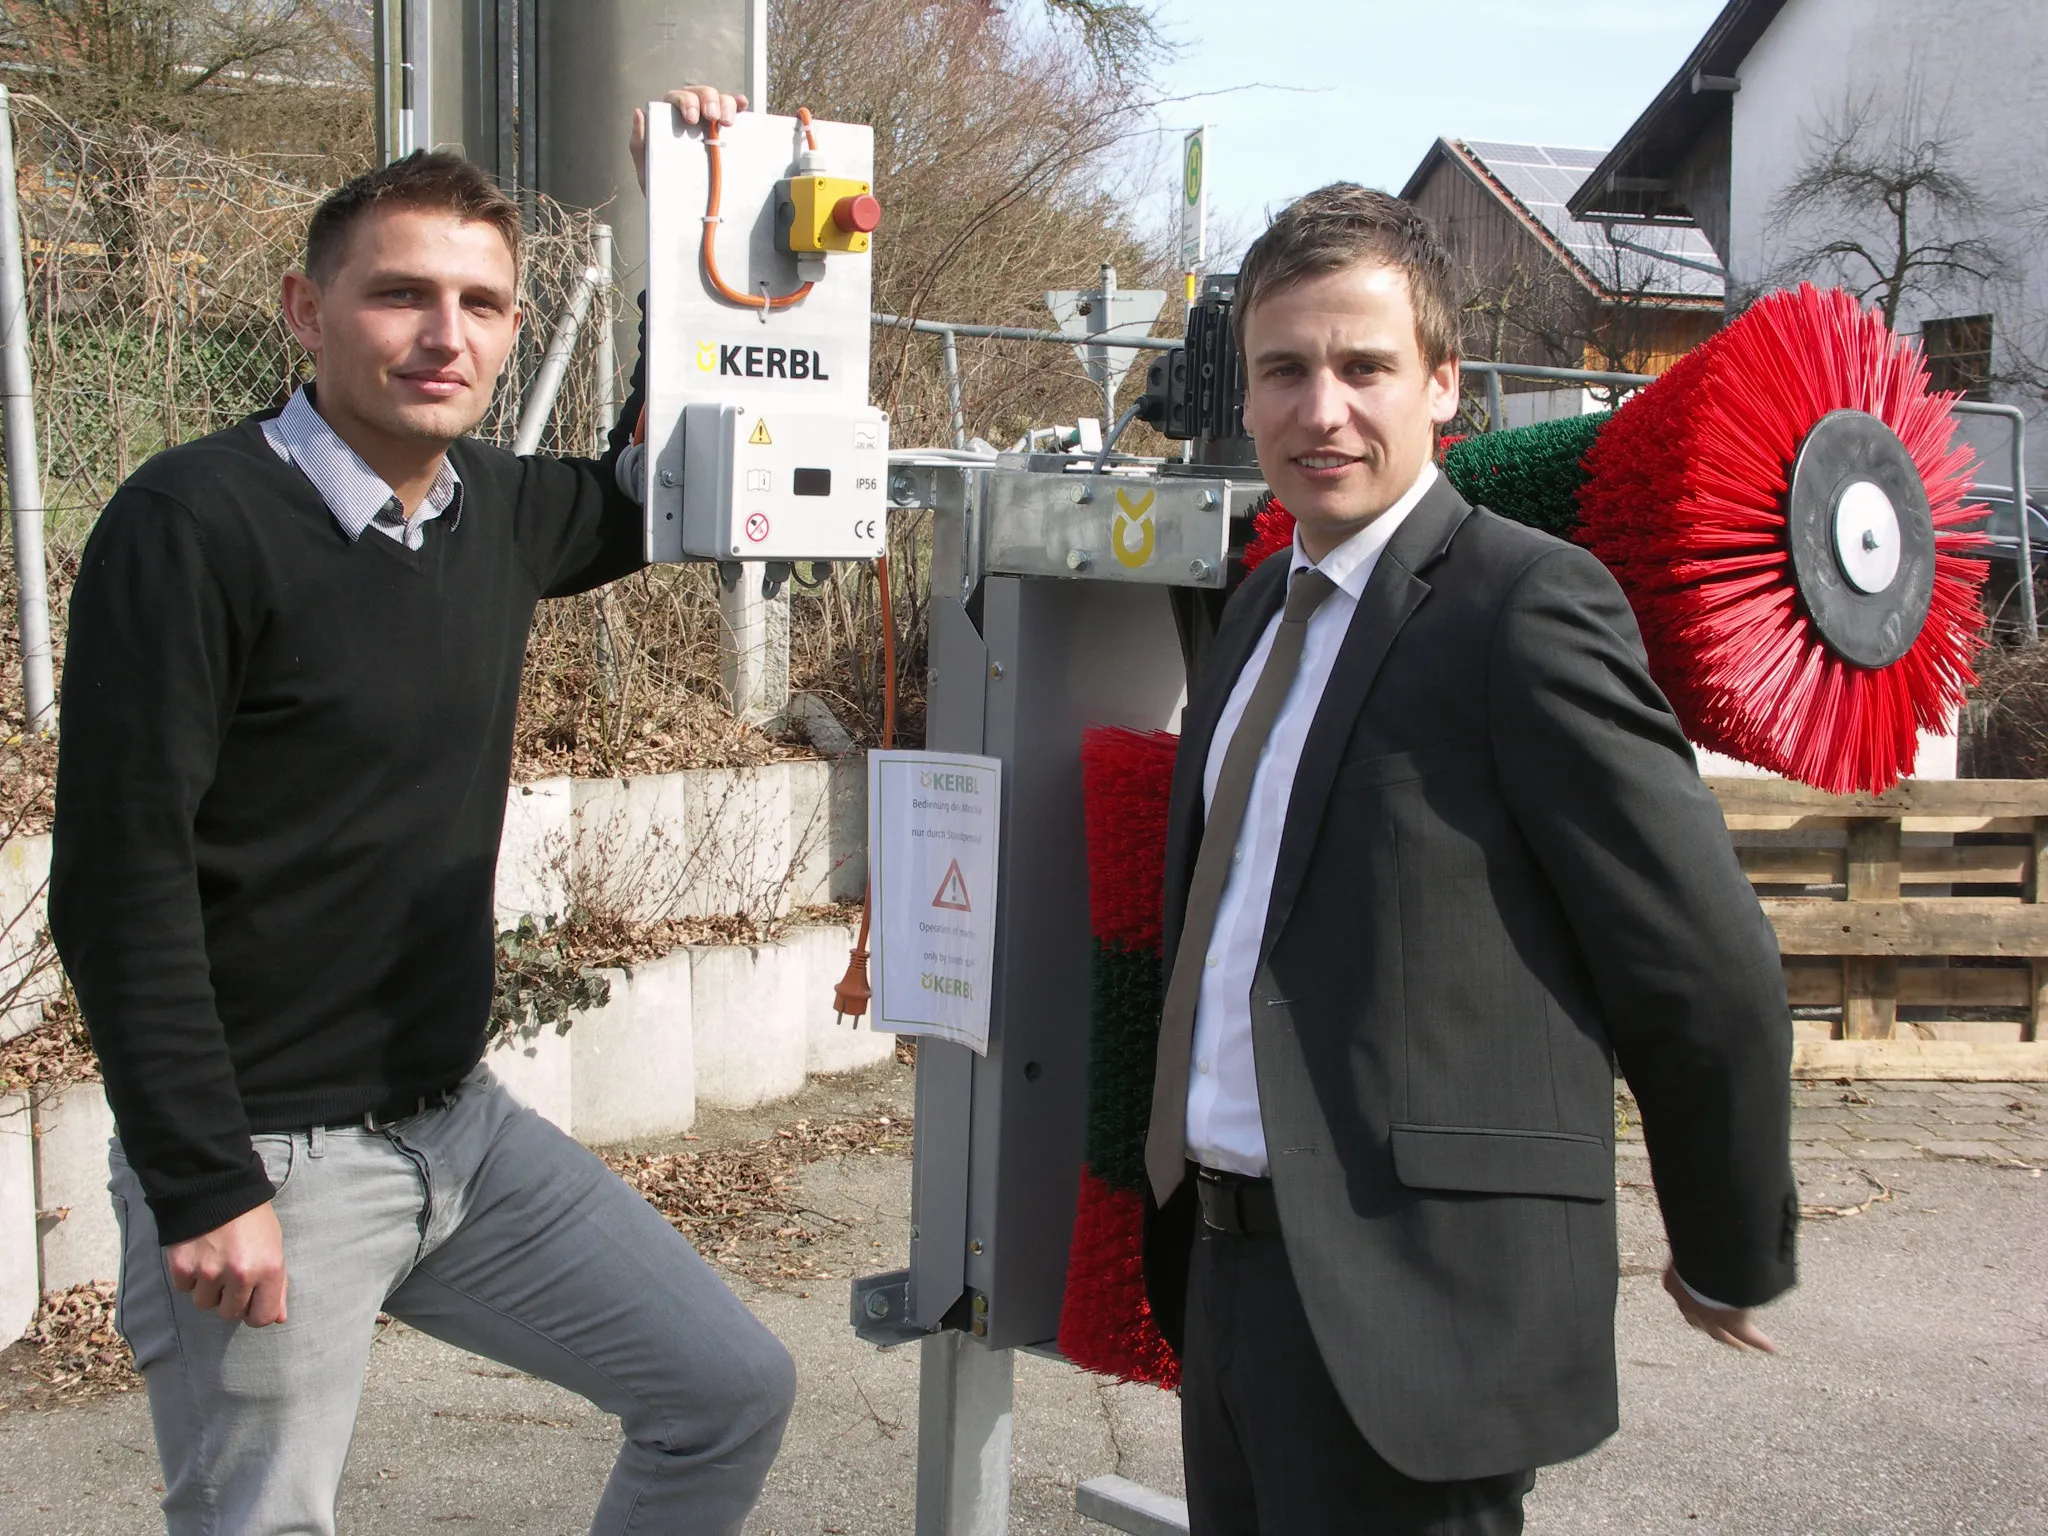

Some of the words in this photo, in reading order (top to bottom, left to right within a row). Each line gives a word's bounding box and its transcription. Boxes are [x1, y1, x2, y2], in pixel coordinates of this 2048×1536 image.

[720, 344, 829, 381] KERBL
[856, 478, 877, 490] IP56
[854, 520, 875, 539] CE
[933, 772, 979, 795] KERBL
[911, 829, 925, 838] nur
[926, 828, 946, 839] durch
[923, 951, 938, 964] only
[934, 975, 973, 1001] KERBL
